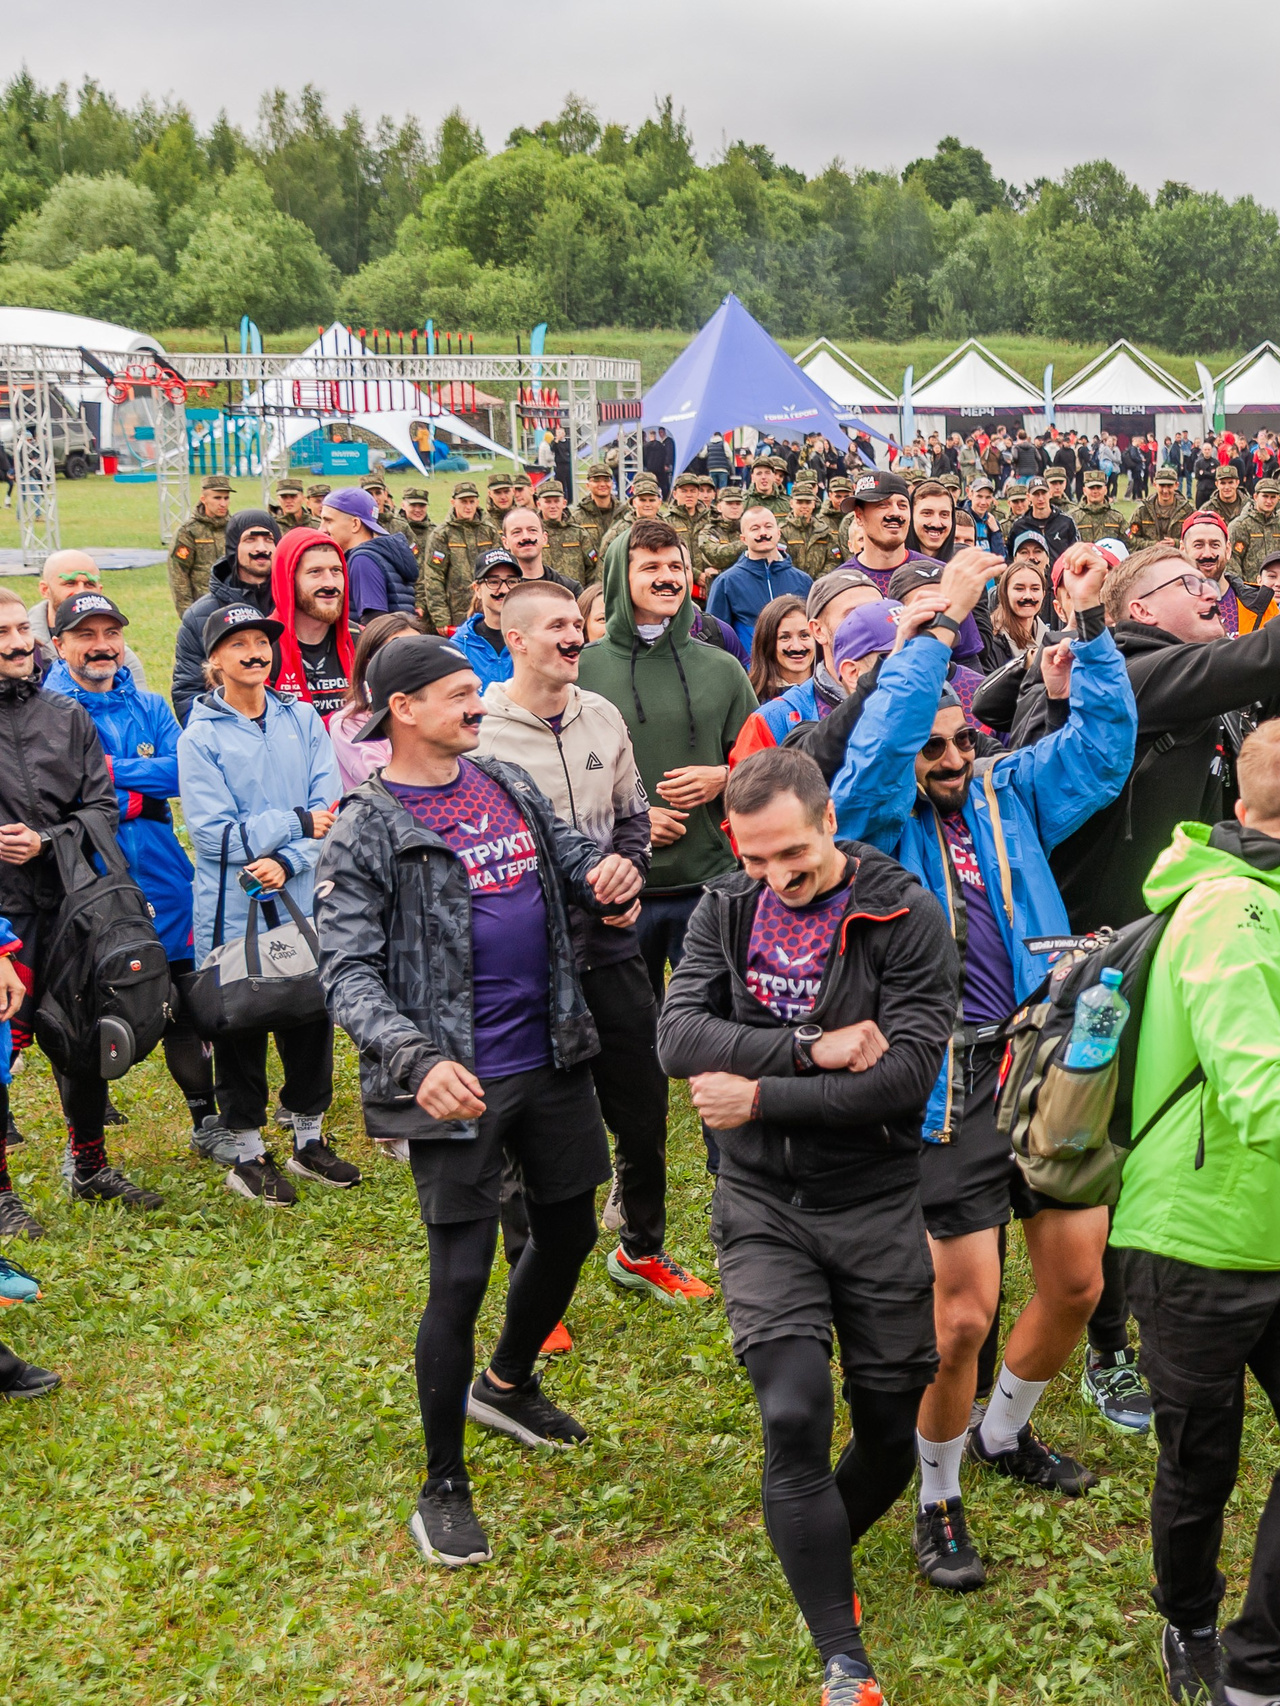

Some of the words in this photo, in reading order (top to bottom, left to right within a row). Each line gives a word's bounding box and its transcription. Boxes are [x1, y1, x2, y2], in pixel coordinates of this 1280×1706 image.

[961, 407, 995, 417] МЕРЧ
[1112, 405, 1146, 415] МЕРЧ
[764, 413, 789, 421] ГОНКА
[957, 868, 985, 887] НК
[270, 949, 298, 961] Kappa
